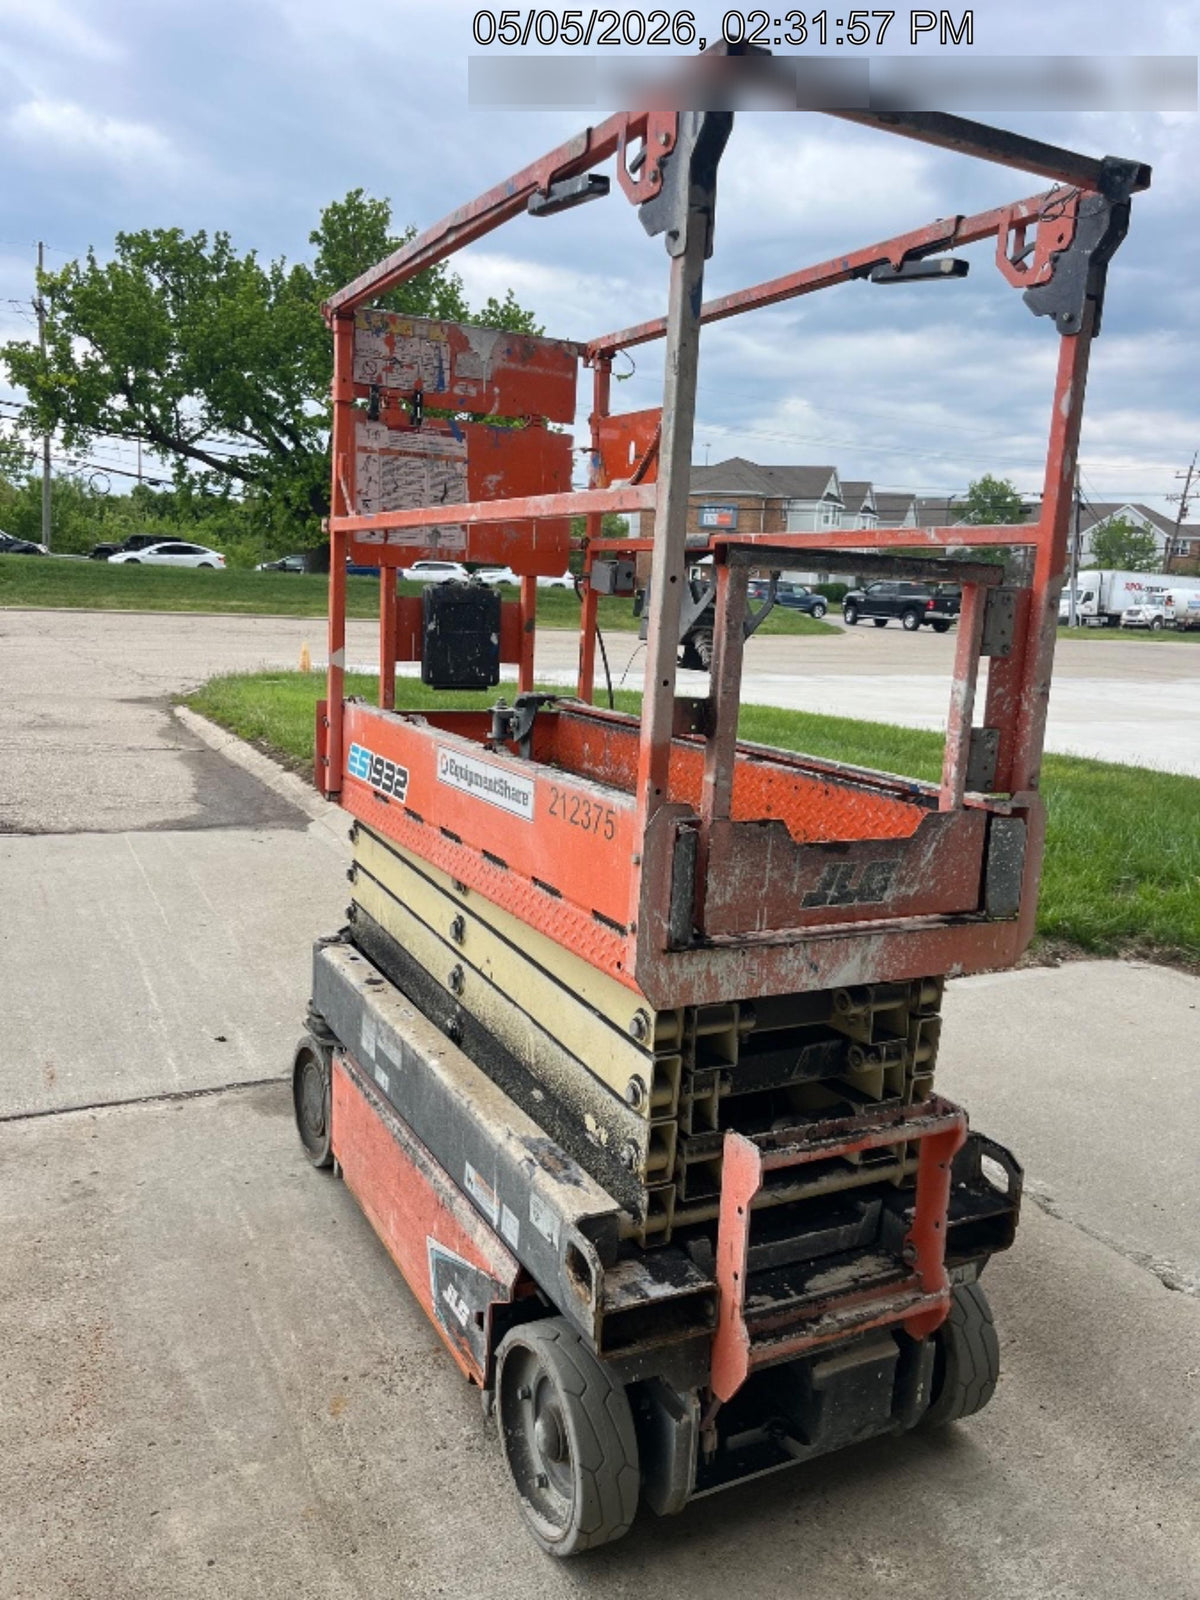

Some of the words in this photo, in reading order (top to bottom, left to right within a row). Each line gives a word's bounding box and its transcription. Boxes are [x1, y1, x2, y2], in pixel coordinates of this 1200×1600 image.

[348, 743, 409, 803] ES1932
[449, 759, 529, 806] EquipmentShare
[548, 786, 616, 840] 212375
[800, 859, 902, 909] JLG
